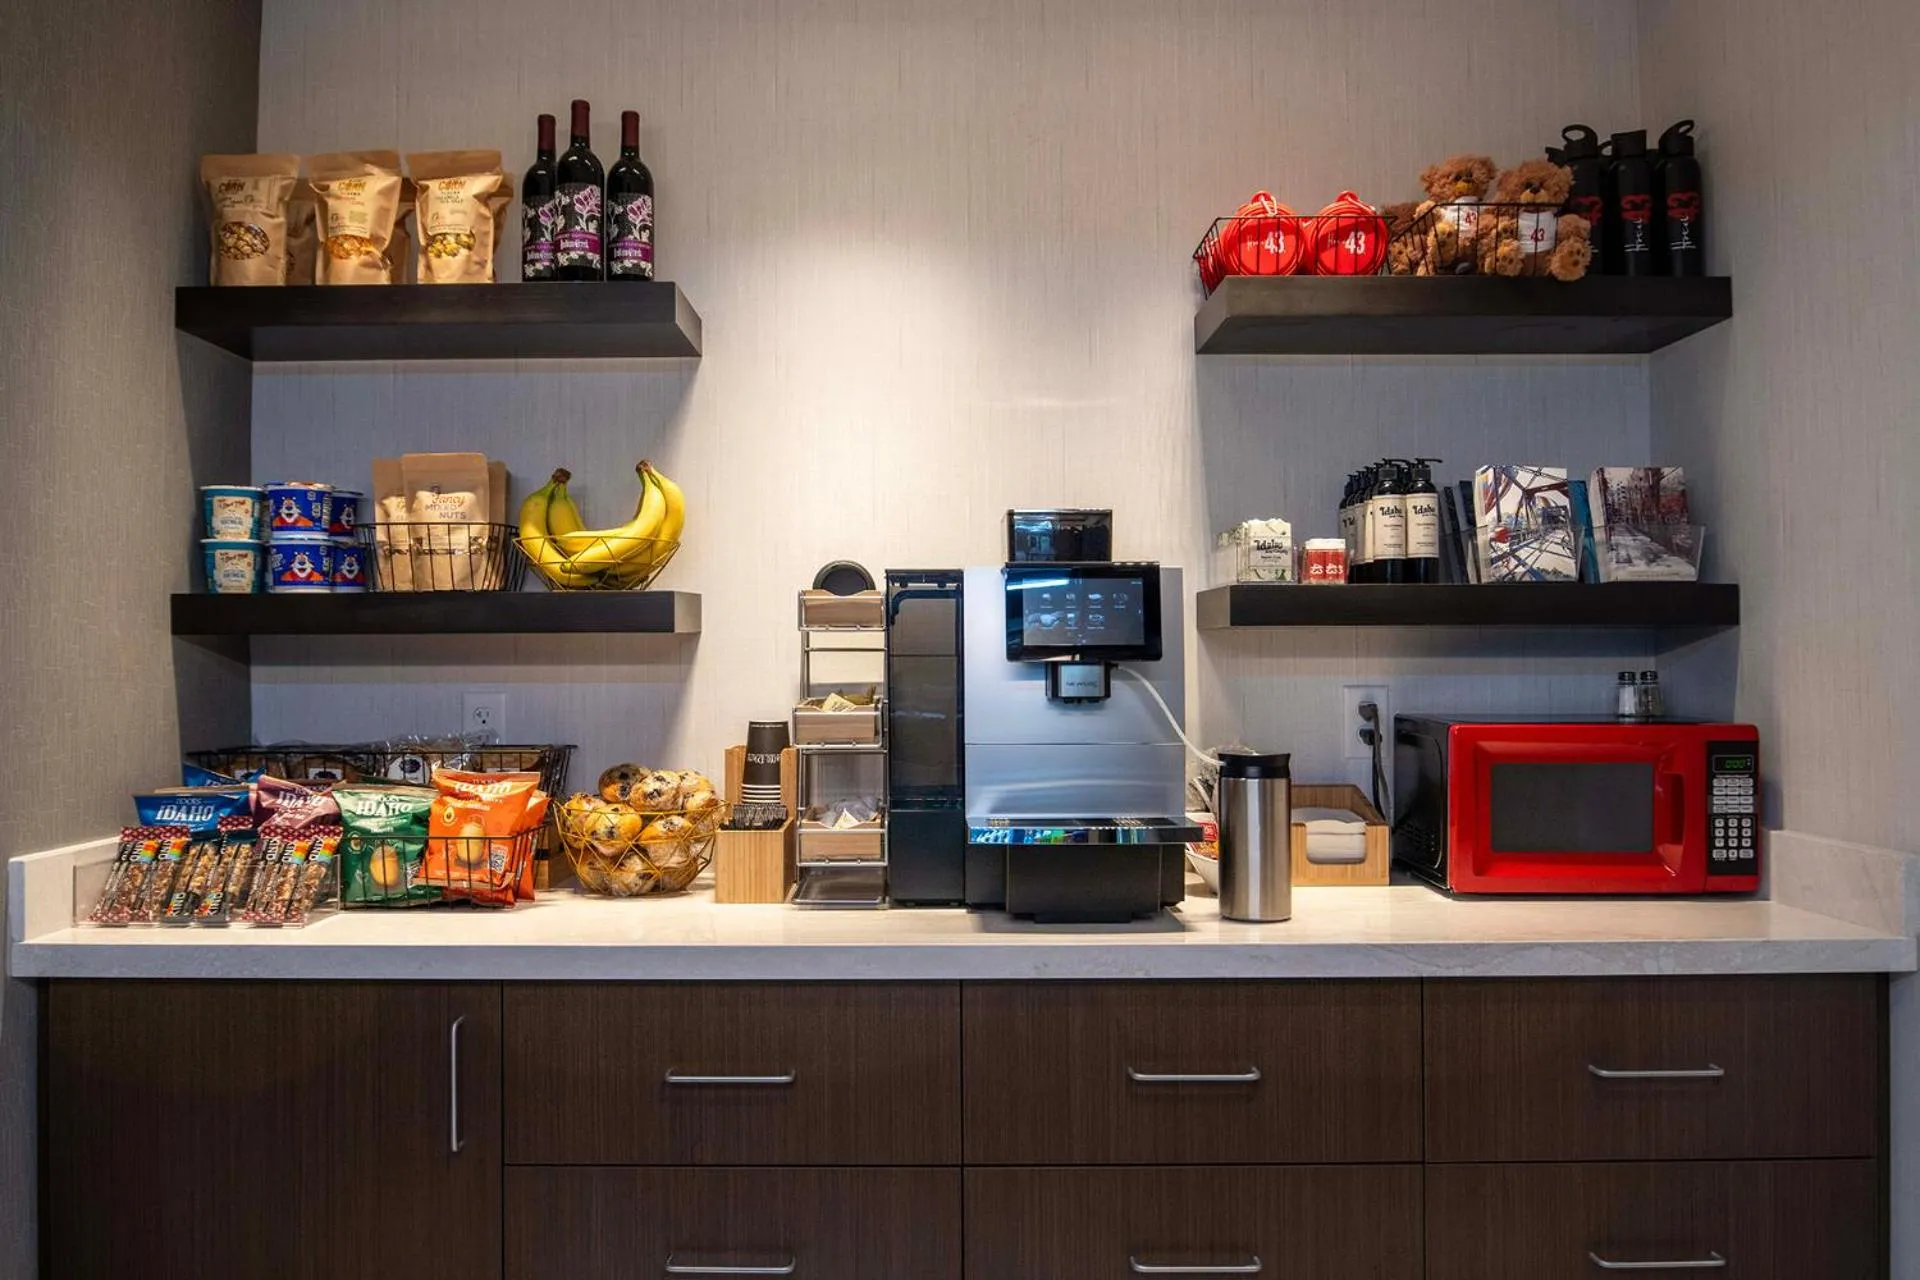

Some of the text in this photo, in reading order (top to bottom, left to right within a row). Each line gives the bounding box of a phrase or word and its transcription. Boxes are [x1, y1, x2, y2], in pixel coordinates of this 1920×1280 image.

[1265, 230, 1285, 254] 43
[1530, 228, 1545, 241] 43
[1345, 231, 1365, 255] 43
[440, 512, 466, 520] NUTS
[155, 804, 214, 820] IDAHO
[355, 801, 411, 817] IDAHO
